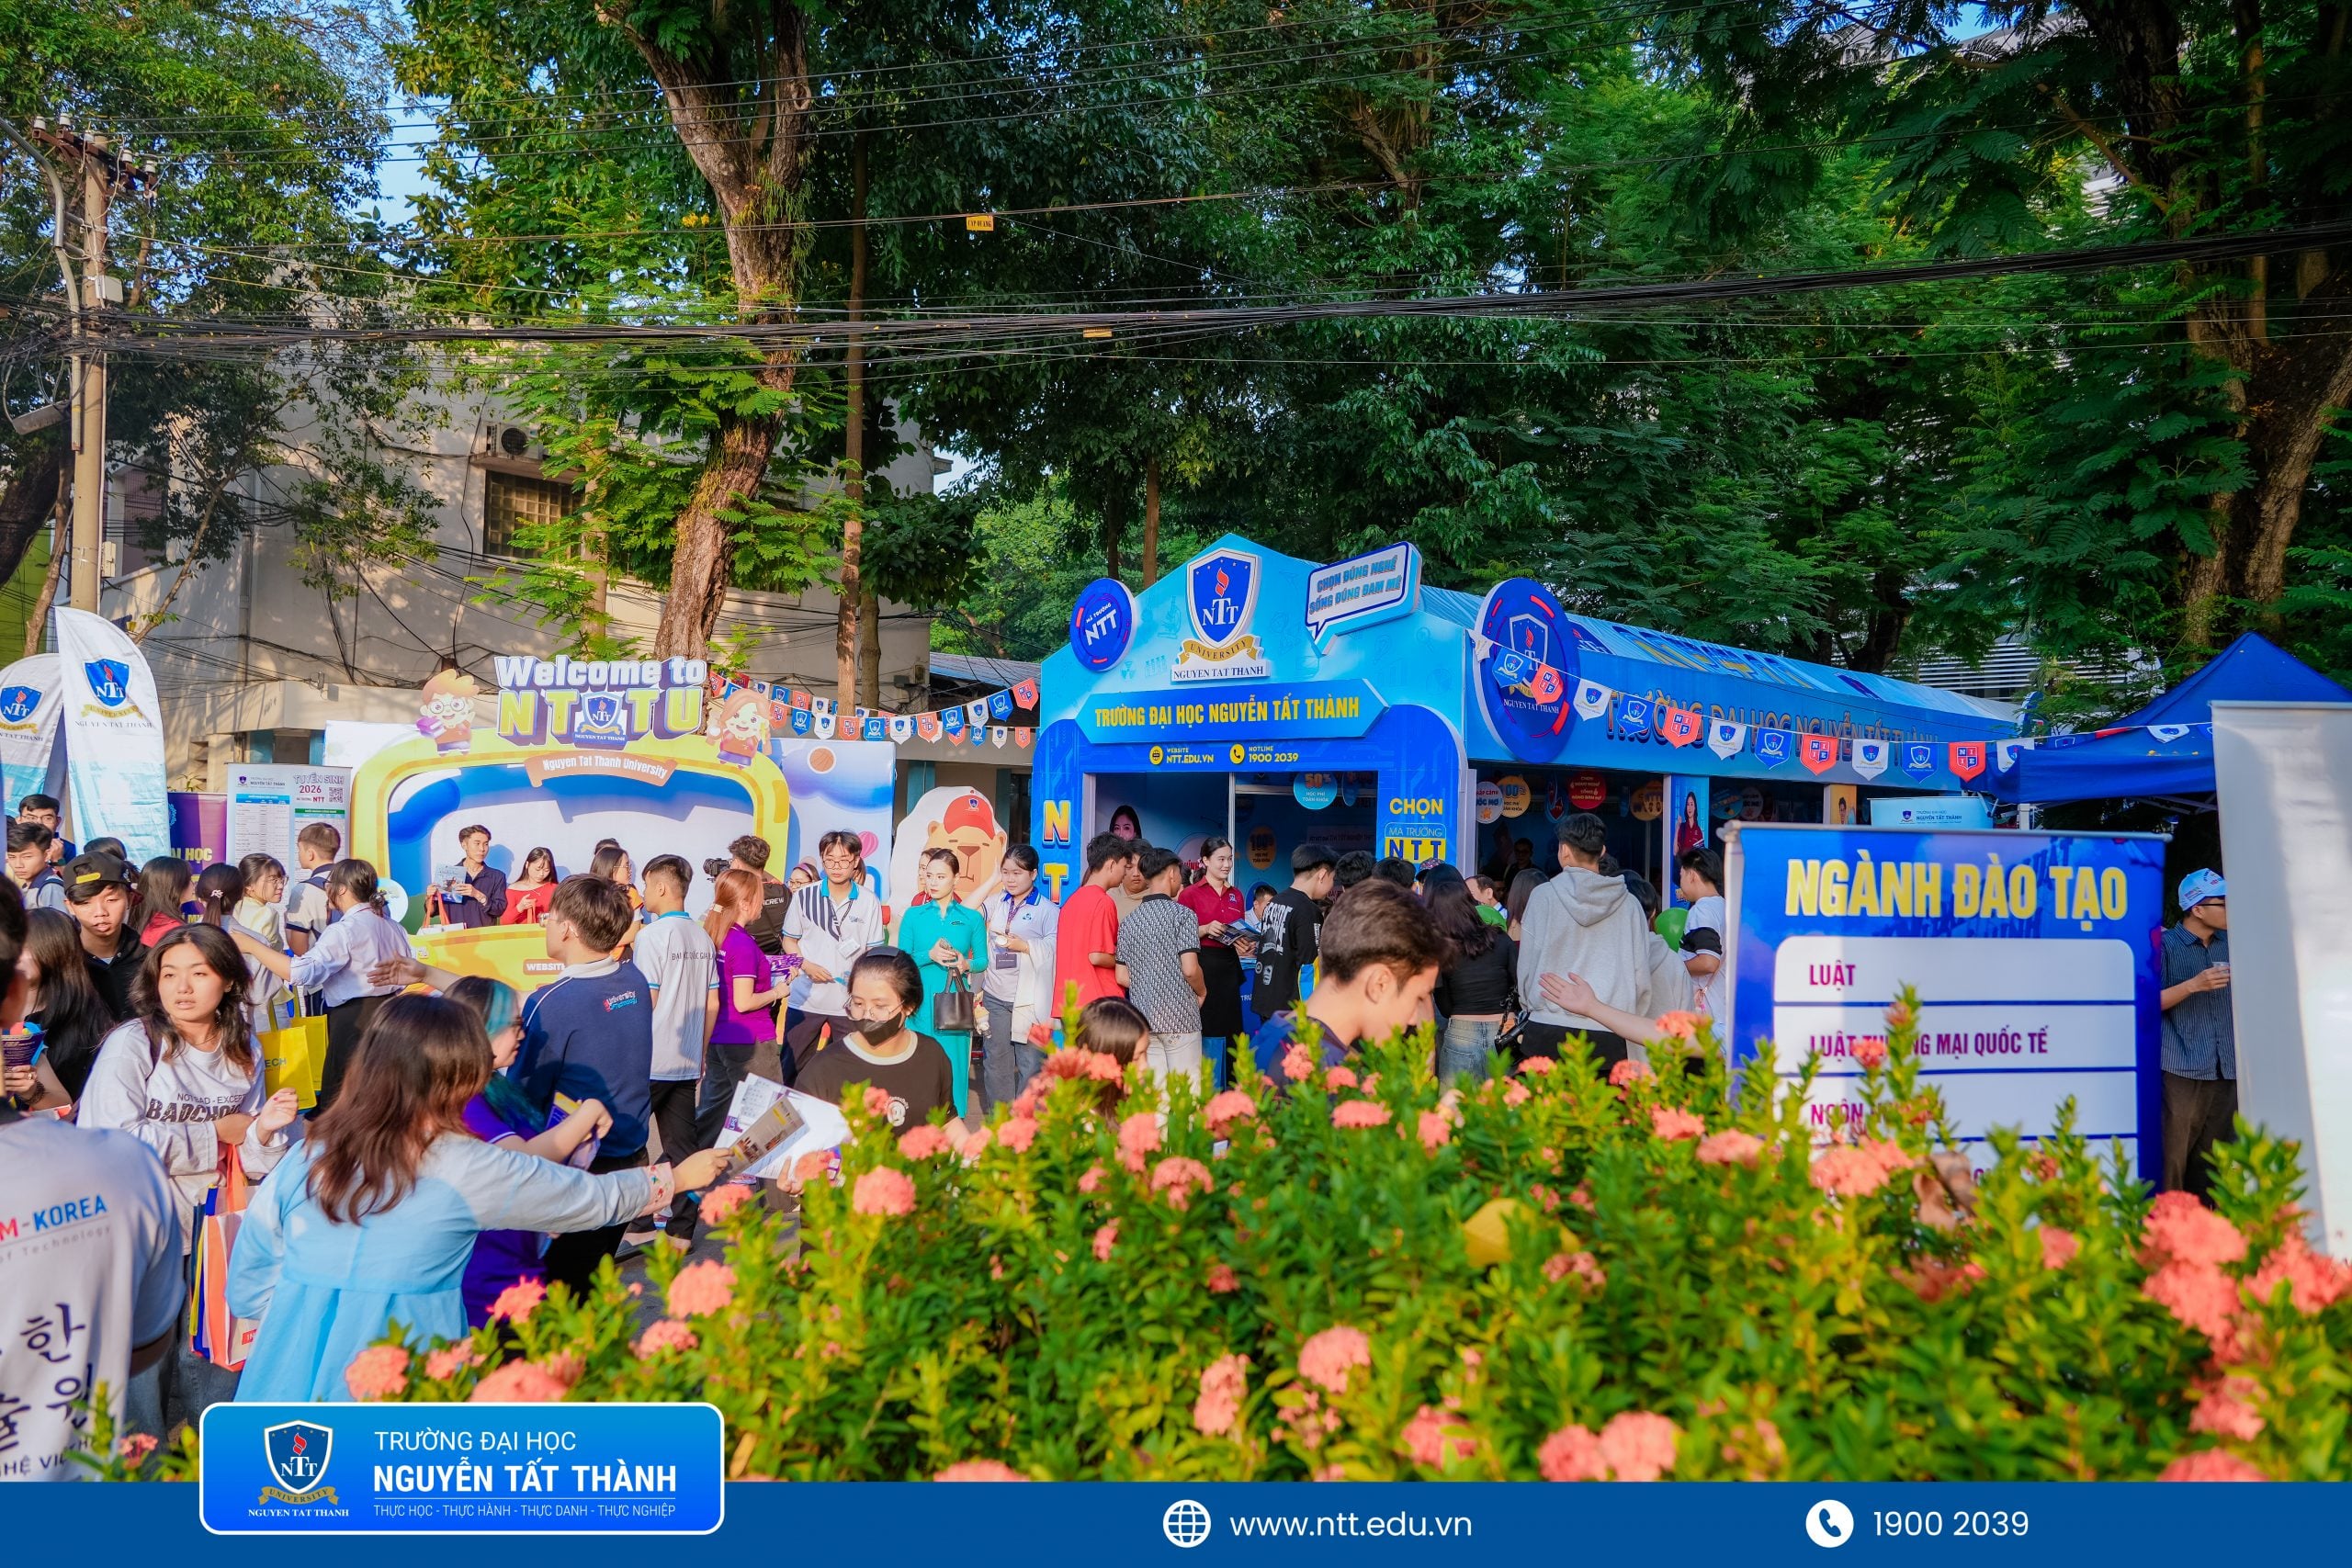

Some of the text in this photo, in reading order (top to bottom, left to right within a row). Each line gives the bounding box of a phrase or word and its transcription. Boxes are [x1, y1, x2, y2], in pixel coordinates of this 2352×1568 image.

[1202, 597, 1238, 626] NTT
[1085, 608, 1117, 646] NTT
[1190, 639, 1247, 660] UNIVERSITY
[495, 655, 707, 687] Welcome to
[1173, 666, 1263, 680] NGUYEN TAT THANH
[96, 682, 125, 698] NTT
[3, 703, 30, 716] NTT
[1095, 693, 1360, 729] TRƯỜNG ĐẠI HỌC NGUYỄN TẤT THÀNH
[1503, 698, 1527, 710] NGUYEN
[1540, 704, 1559, 714] THANH
[592, 711, 611, 722] NTT
[1166, 755, 1215, 764] NTT.EDU.VN
[1249, 752, 1299, 763] 1900 2039
[543, 755, 668, 779] Nguyen Tat Thanh University
[300, 785, 322, 794] 2026
[1389, 797, 1443, 819] CHỌN
[185, 848, 213, 863] HỌC
[1785, 849, 1942, 919] NGÀNH
[1951, 852, 2038, 919] ĐÀO
[2049, 865, 2129, 932] TẠO
[763, 897, 785, 907] CREW
[1809, 959, 1856, 988] LUẬT
[1936, 1032, 1969, 1059] MẠI
[1974, 1025, 2022, 1057] QUỐC
[2028, 1025, 2050, 1055] TẾ
[265, 1057, 288, 1068] ECH
